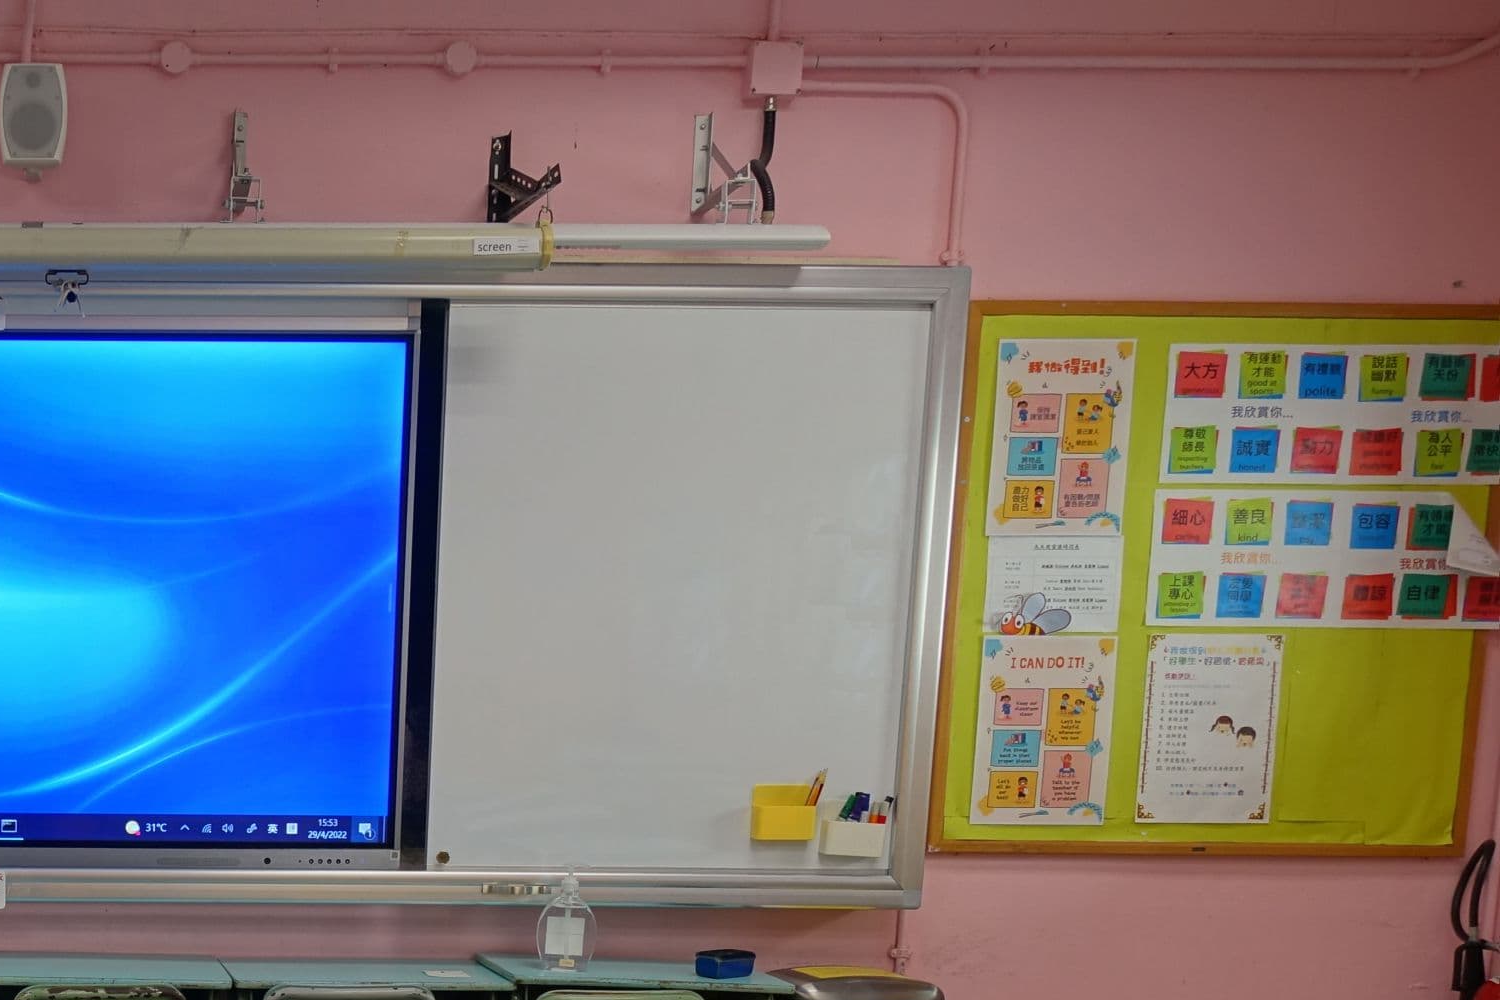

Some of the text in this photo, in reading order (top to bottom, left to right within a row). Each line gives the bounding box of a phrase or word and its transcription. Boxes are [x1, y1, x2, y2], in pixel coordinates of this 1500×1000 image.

[477, 242, 512, 252] screen
[1247, 353, 1281, 364] 有運動
[1372, 356, 1397, 368] 說話
[1185, 362, 1219, 379] 大方
[1252, 367, 1275, 378] 才能
[1247, 379, 1267, 388] good
[1304, 386, 1336, 397] polite
[1236, 440, 1272, 457] 誠實
[1172, 509, 1206, 525] 細心
[1234, 508, 1266, 525] 善良
[1358, 513, 1391, 529] 包容
[1238, 533, 1258, 542] kind
[1169, 575, 1195, 587] 上課
[1168, 588, 1194, 600] 專心
[1407, 585, 1440, 600] 自律
[1010, 657, 1085, 669] I CAN DO IT!
[145, 822, 168, 833] 31°C
[319, 819, 338, 827] 15:53
[308, 830, 347, 839] 29/4/2022
